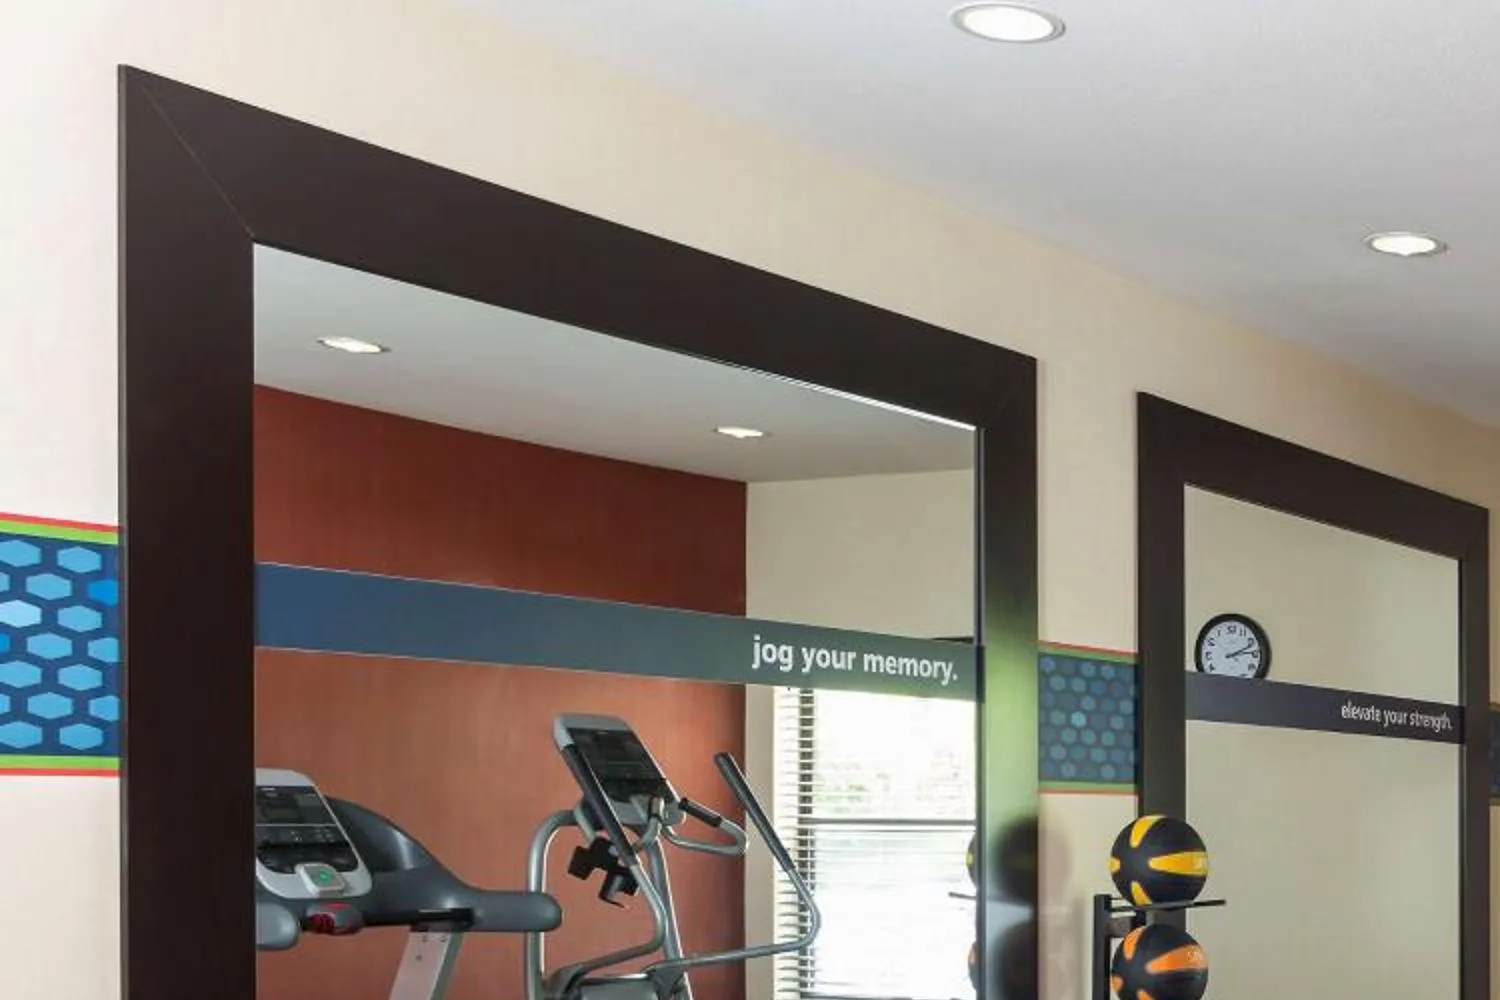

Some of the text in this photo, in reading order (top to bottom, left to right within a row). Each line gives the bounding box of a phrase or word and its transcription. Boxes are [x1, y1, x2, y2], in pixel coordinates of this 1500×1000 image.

[751, 634, 958, 685] jog your memory.
[1341, 699, 1381, 722] elevate
[1383, 710, 1409, 728] your
